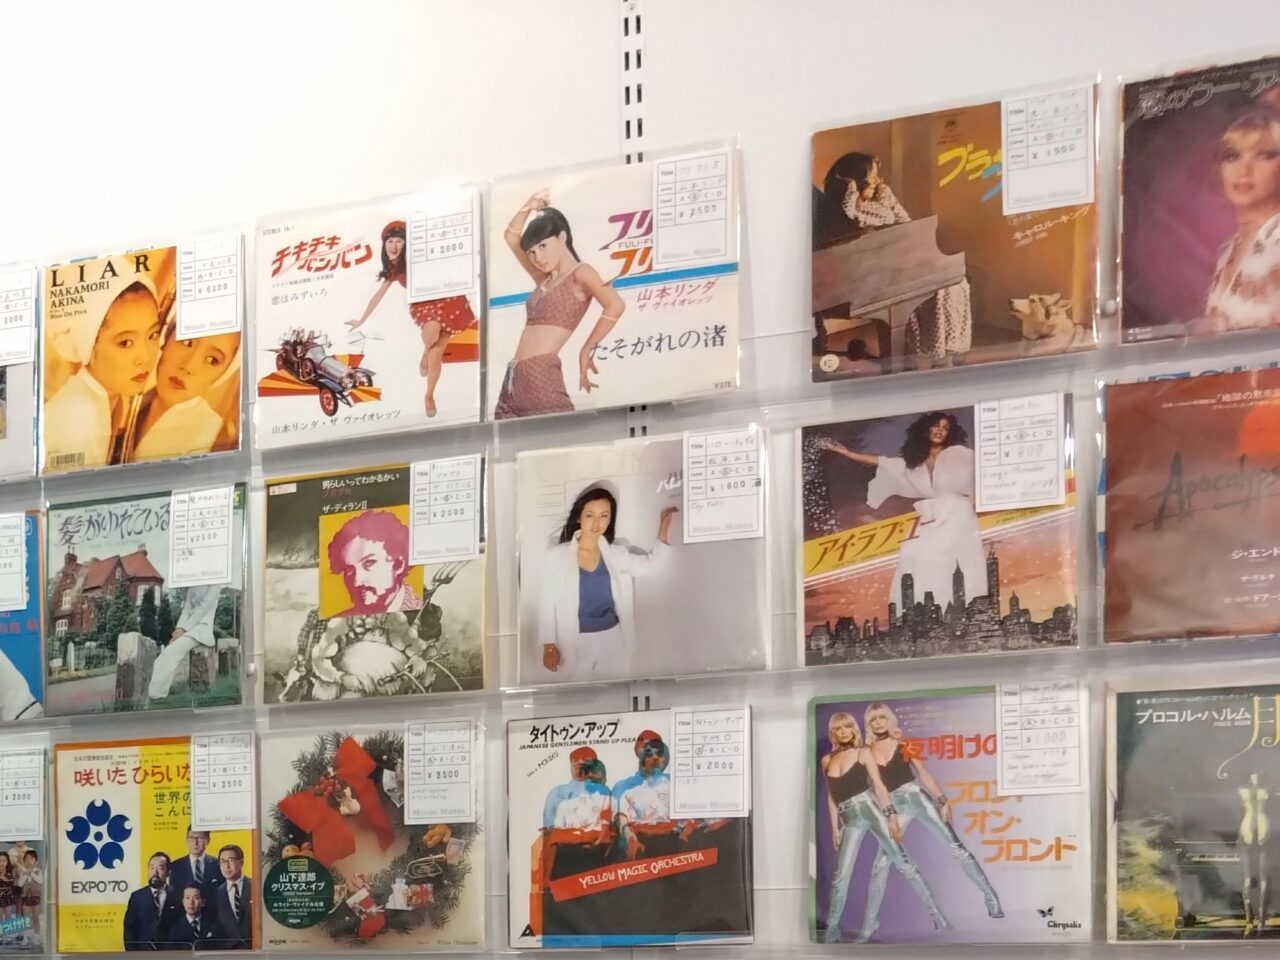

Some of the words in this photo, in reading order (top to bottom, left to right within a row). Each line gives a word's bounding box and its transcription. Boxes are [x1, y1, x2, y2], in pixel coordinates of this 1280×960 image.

[938, 143, 1002, 188] ブラ
[272, 235, 341, 278] チキチキ
[298, 243, 373, 272] バンバン
[51, 254, 152, 288] LIAR
[50, 280, 110, 299] NAKAMORI
[272, 288, 328, 305] 恋はみずいろ
[637, 279, 718, 303] 山本リンダ
[50, 295, 85, 310] AKINA
[589, 325, 728, 361] たそがれの渚
[322, 472, 400, 490] 男らしいってわかるかい
[1136, 707, 1252, 724] プロコル・ハルム
[530, 719, 620, 743] タイトゥン・アップ
[519, 742, 549, 751] JAPANESE
[550, 741, 587, 749] GENTLEMEN
[706, 761, 734, 770] 2000
[74, 767, 128, 787] 咲いた
[133, 763, 191, 785] ひらいた
[154, 791, 191, 804] 世界の
[154, 806, 191, 817] こんに
[279, 872, 317, 883] 山下達郎
[579, 871, 615, 888] YELLOW
[618, 864, 649, 882] MAGIC
[650, 851, 704, 874] ORCHESTRA
[271, 881, 325, 892] クリスマス・イブ
[1047, 920, 1082, 930] Chrysalis
